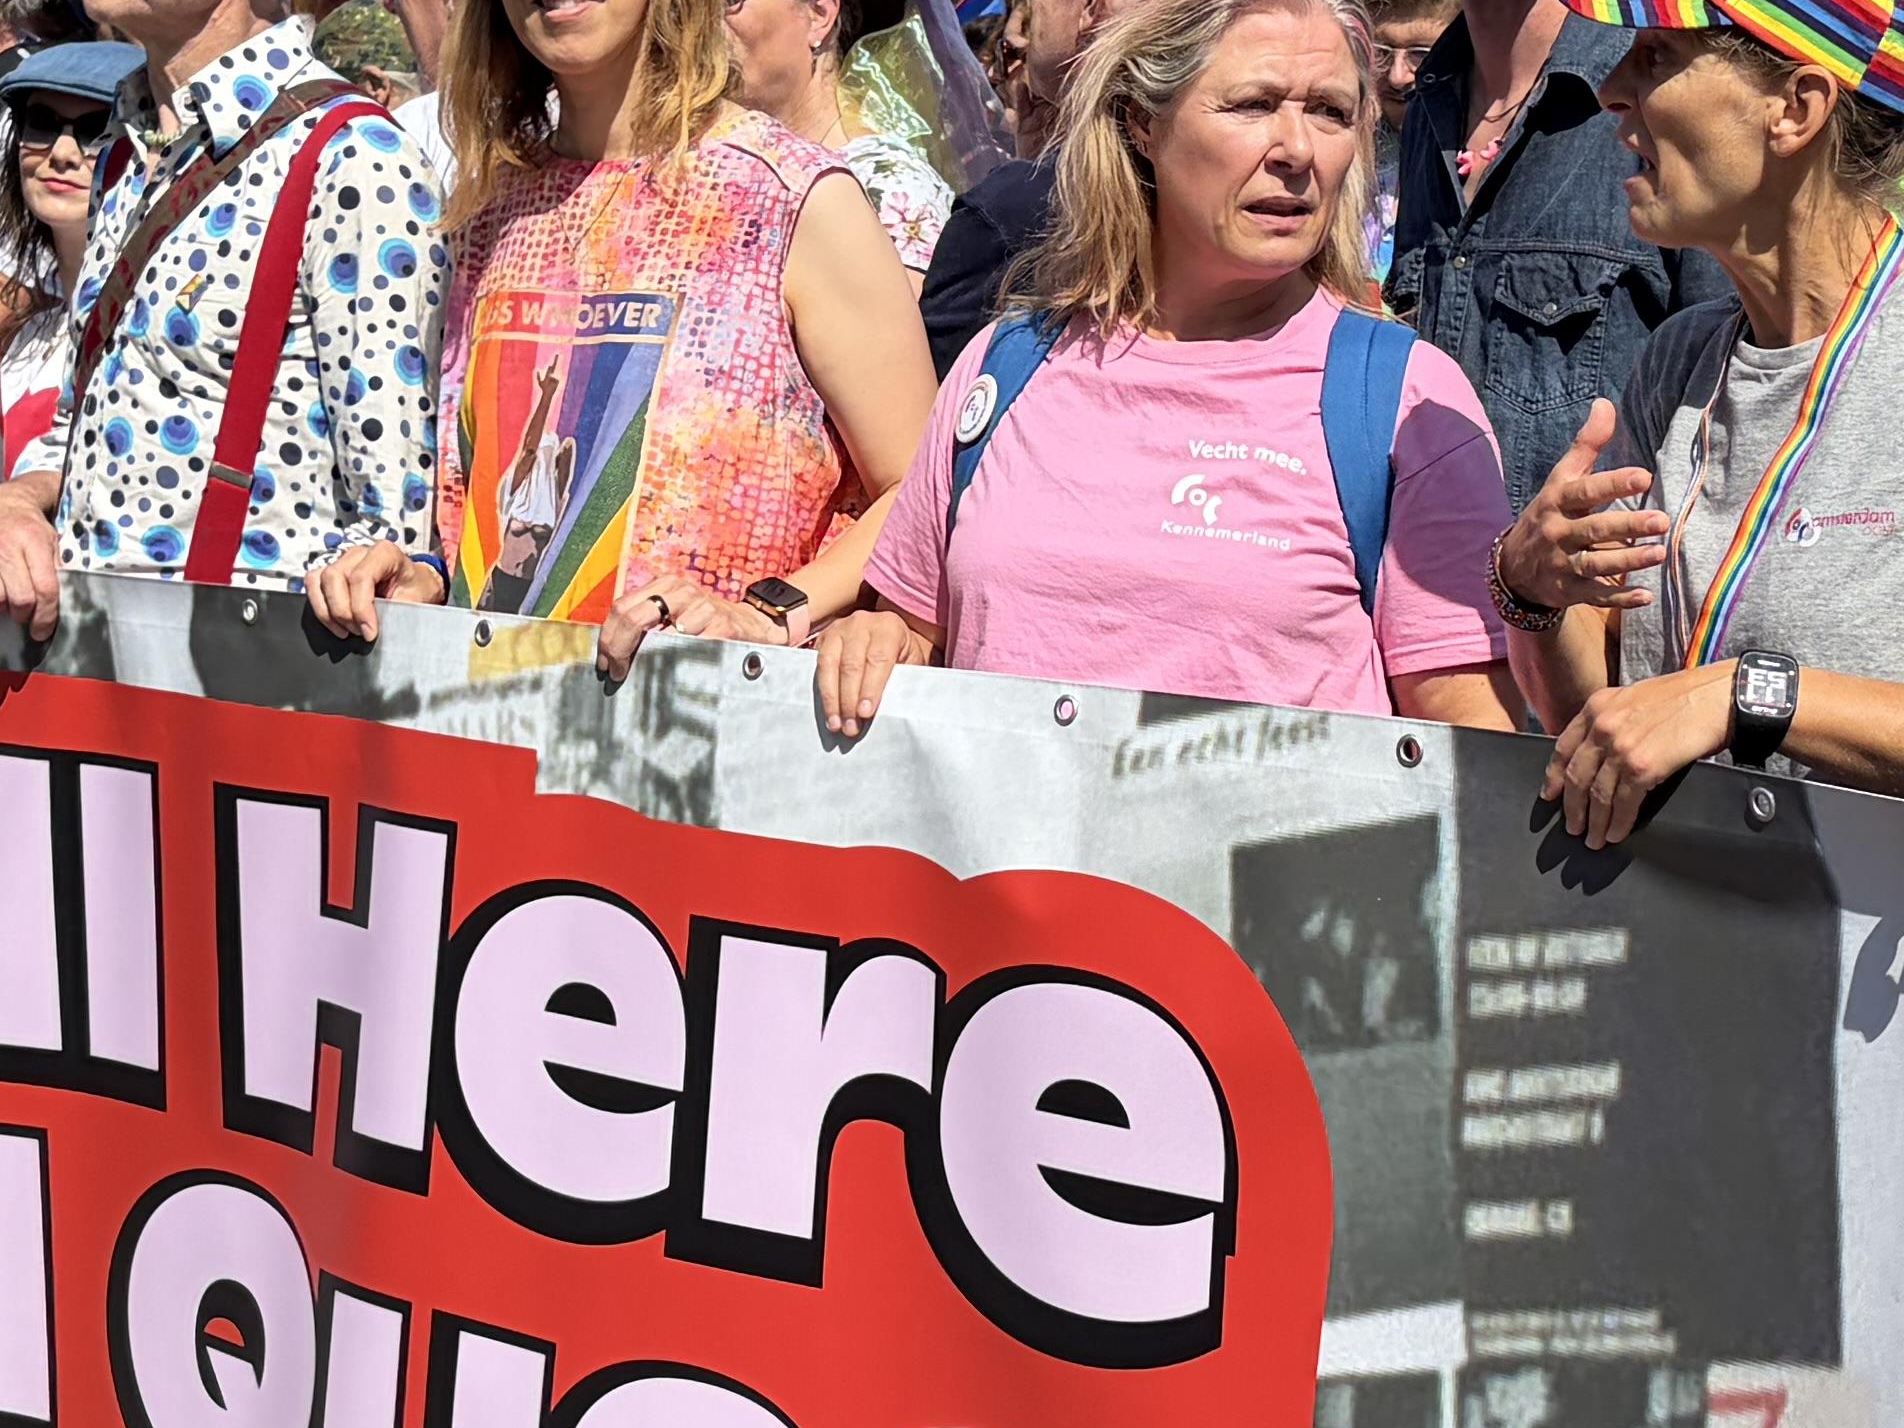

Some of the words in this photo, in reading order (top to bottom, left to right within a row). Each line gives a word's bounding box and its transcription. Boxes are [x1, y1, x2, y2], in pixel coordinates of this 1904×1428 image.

[522, 299, 663, 330] WHOEVER
[1188, 439, 1249, 461] Vecht
[1254, 446, 1307, 476] mee.
[1160, 519, 1292, 552] Kennemerland
[220, 785, 1236, 1362] Here
